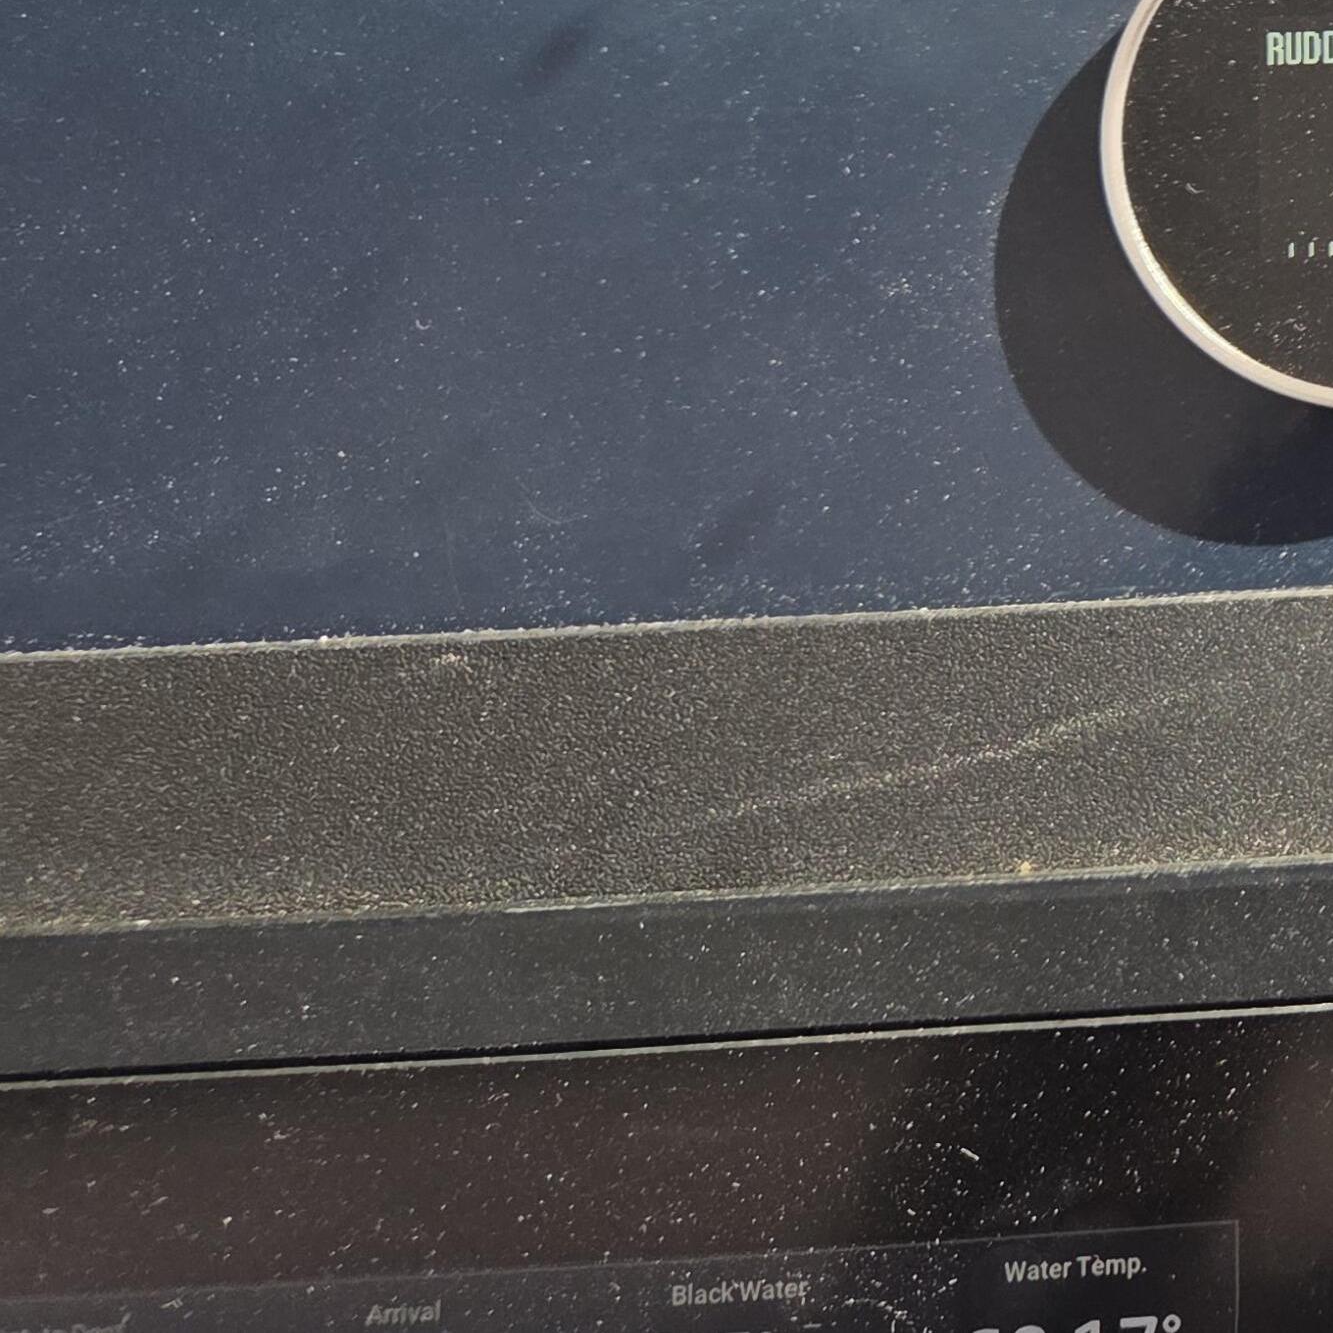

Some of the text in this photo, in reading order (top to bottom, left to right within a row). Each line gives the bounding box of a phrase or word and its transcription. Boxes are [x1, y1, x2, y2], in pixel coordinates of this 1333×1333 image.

[1004, 1255, 1147, 1283] Water Temp.
[671, 1278, 809, 1306] Black Water
[365, 1297, 442, 1327] Arrival
